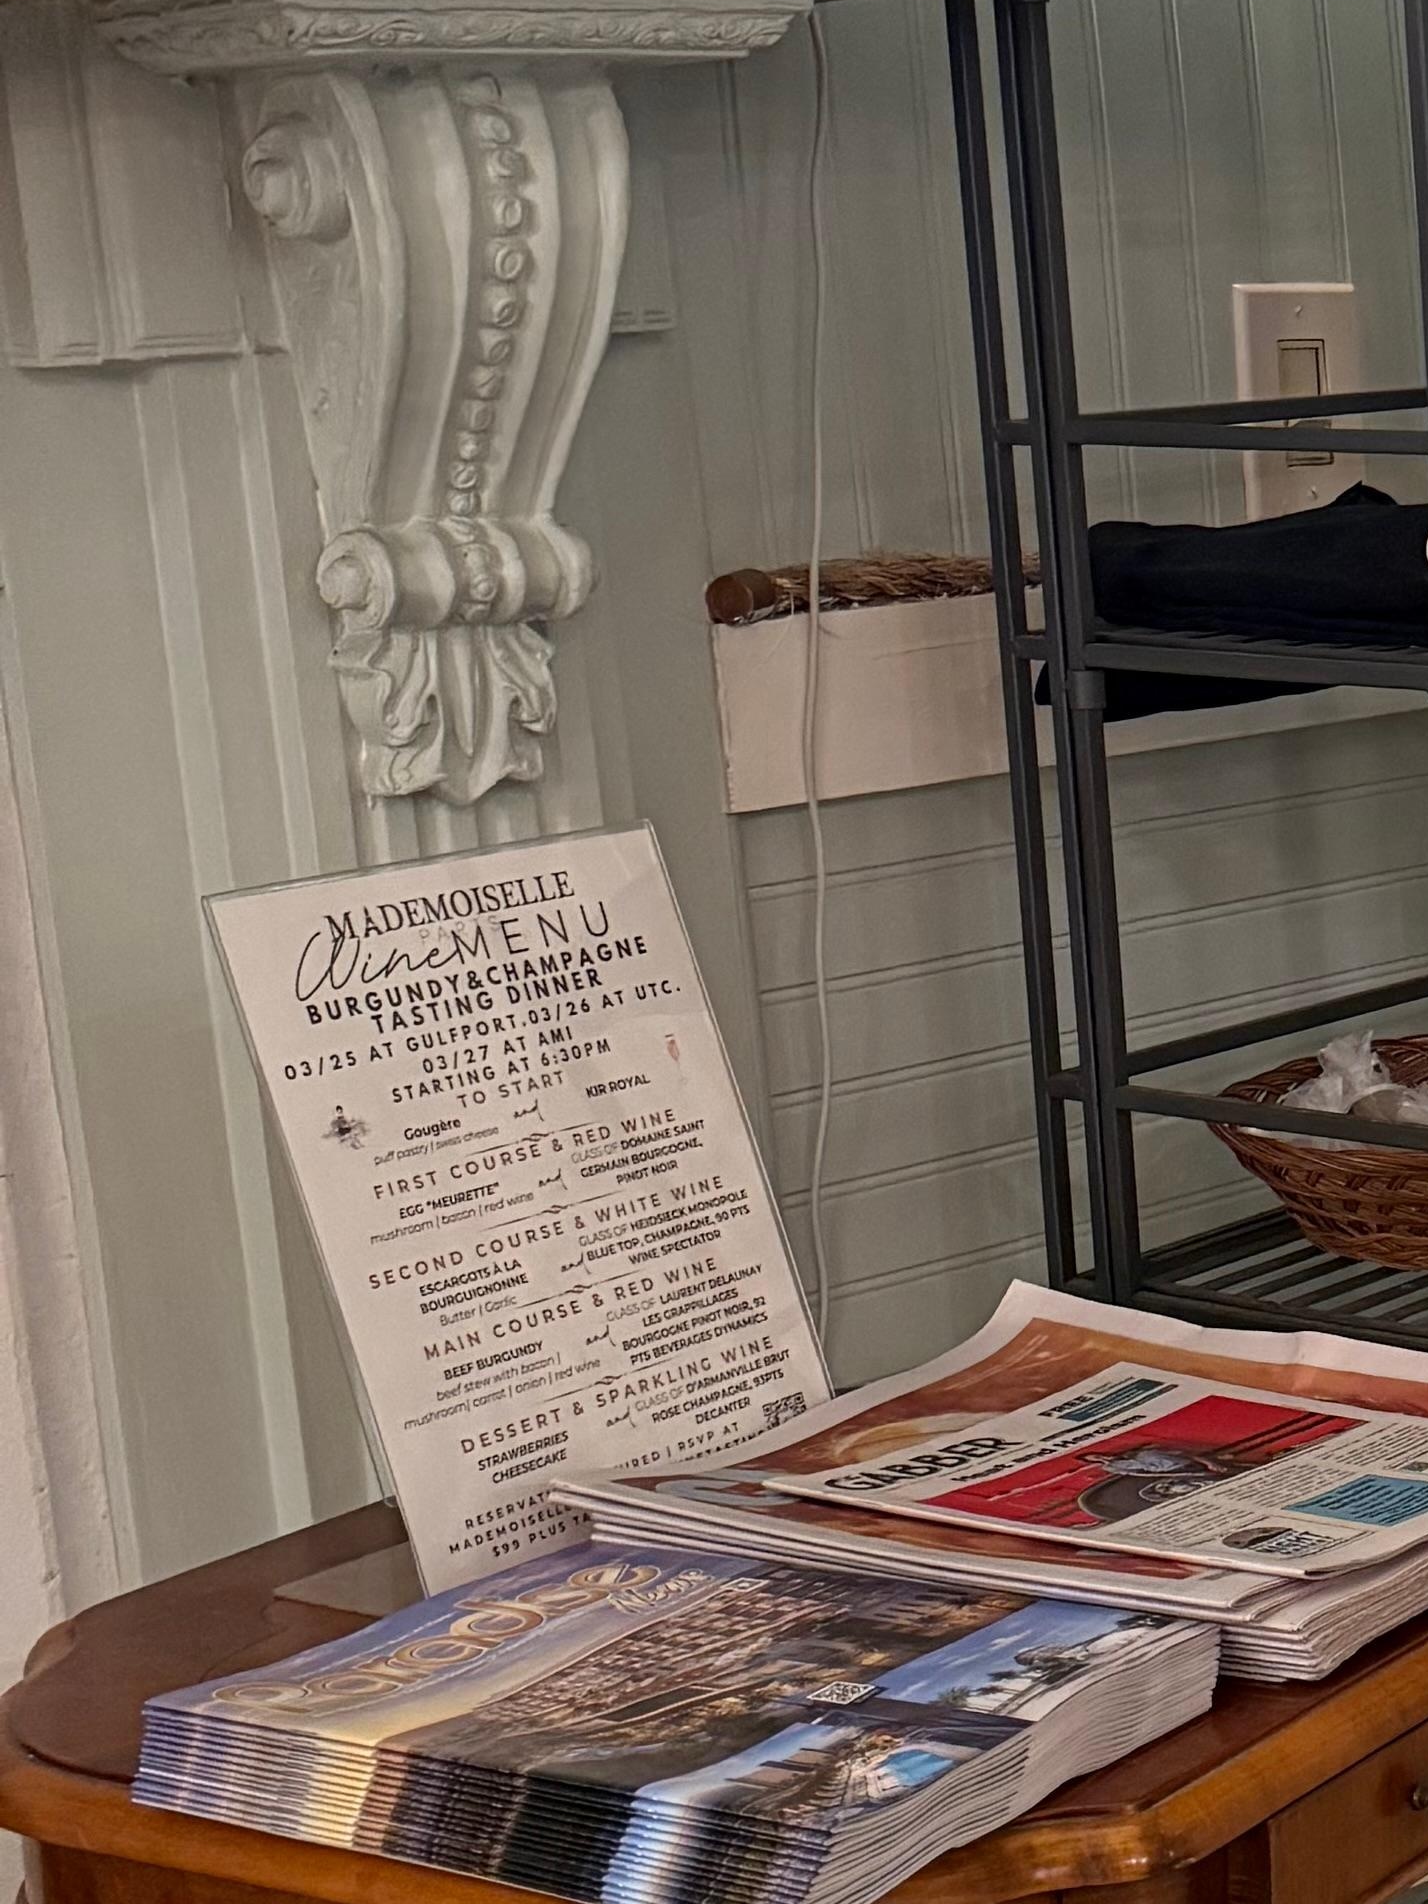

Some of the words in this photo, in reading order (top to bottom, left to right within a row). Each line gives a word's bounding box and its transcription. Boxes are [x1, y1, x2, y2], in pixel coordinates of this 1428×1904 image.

[323, 870, 574, 943] MADEMOISELLE
[295, 907, 464, 1001] Wine
[450, 901, 608, 964] MENU
[284, 1050, 356, 1080] 03/25
[370, 1041, 392, 1061] AT
[602, 990, 623, 1008] AT
[634, 979, 680, 1000] UTC.
[370, 991, 493, 1033] TASTING
[505, 968, 602, 1004] DINNER
[391, 1065, 495, 1103] STARTING
[508, 1056, 529, 1075] AT
[540, 1038, 610, 1066] 6:30PM
[422, 1044, 488, 1073] 03/27
[503, 1035, 525, 1055] AT
[538, 1025, 572, 1046] AMI
[403, 1119, 460, 1140] Gougère
[608, 1074, 650, 1092] ROYAL
[456, 1090, 485, 1107] TO
[497, 1070, 562, 1098] START
[373, 1170, 436, 1199] FIRST
[449, 1143, 541, 1178] COURSE
[551, 1138, 563, 1152] &
[572, 1126, 610, 1146] RED
[620, 1108, 675, 1133] WINE
[620, 1127, 671, 1150] DOMAINE
[673, 1119, 704, 1136] SAINT
[399, 1203, 424, 1219] EGG
[580, 1156, 629, 1177] GERMAIN
[615, 1167, 648, 1184] PINOT
[650, 1159, 678, 1174] NOIR
[687, 1188, 747, 1213] MONOPOLE
[368, 1250, 463, 1289] SECOND
[475, 1220, 563, 1257] COURSE
[574, 1215, 585, 1229] &
[594, 1192, 661, 1222] WHITE
[670, 1175, 723, 1200] WINE
[419, 1273, 528, 1314] BOURGUIGNONNE
[586, 1243, 617, 1261] BLUE
[729, 1204, 750, 1217] PTS
[628, 1247, 660, 1264] WINE
[660, 1229, 721, 1255] SPECTATOR
[419, 1266, 490, 1296] ESCARGOTS
[503, 1259, 521, 1271] LA
[423, 1330, 481, 1360] MAIN
[492, 1299, 582, 1337] COURSE
[591, 1293, 603, 1307] &
[613, 1277, 653, 1300] RED
[663, 1257, 716, 1283] WINE
[659, 1281, 706, 1304] LAURENT
[708, 1263, 761, 1289] DELAUNAY
[443, 1361, 473, 1380] BEEF
[475, 1340, 542, 1370] BURGUNDY
[642, 1312, 662, 1327] LES
[629, 1350, 651, 1365] PTS
[651, 1329, 712, 1358] BEVERAGES
[713, 1311, 768, 1337] DYNAMICS
[691, 1309, 721, 1327] PINOT
[763, 1348, 789, 1366] BRUT
[460, 1407, 560, 1453] DESSERT
[572, 1401, 583, 1415] &
[595, 1357, 711, 1407] SPARKLING
[720, 1335, 773, 1363] WINE
[477, 1430, 568, 1471] STRAWBERRIES
[651, 1404, 681, 1423] ROSE
[492, 1447, 566, 1483] CHEESECAKE
[695, 1396, 750, 1424] DECANTER
[677, 1430, 714, 1450] RSVP
[722, 1421, 738, 1434] AT
[824, 1437, 1026, 1491] GABBER
[492, 1539, 519, 1557] $99
[528, 1521, 565, 1543] PLUS
[572, 1510, 592, 1525] TA
